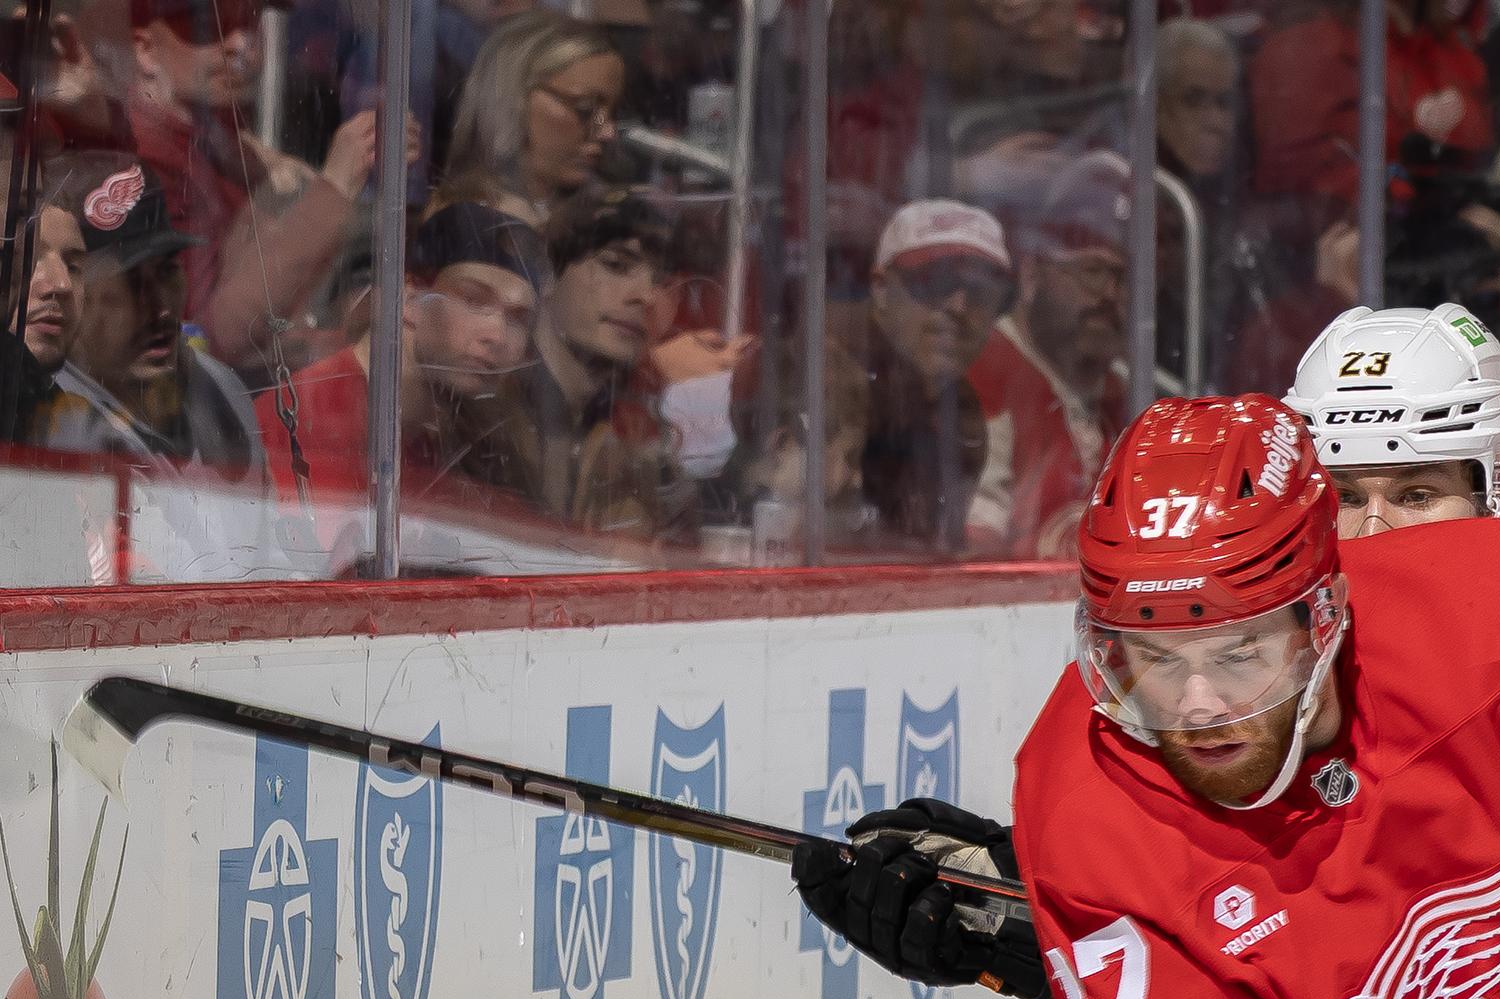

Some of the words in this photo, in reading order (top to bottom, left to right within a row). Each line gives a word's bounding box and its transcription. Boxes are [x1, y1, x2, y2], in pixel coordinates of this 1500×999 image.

[1338, 351, 1392, 378] 23
[1325, 409, 1406, 425] CCM
[1139, 496, 1200, 538] 37
[1125, 577, 1207, 593] BAUER
